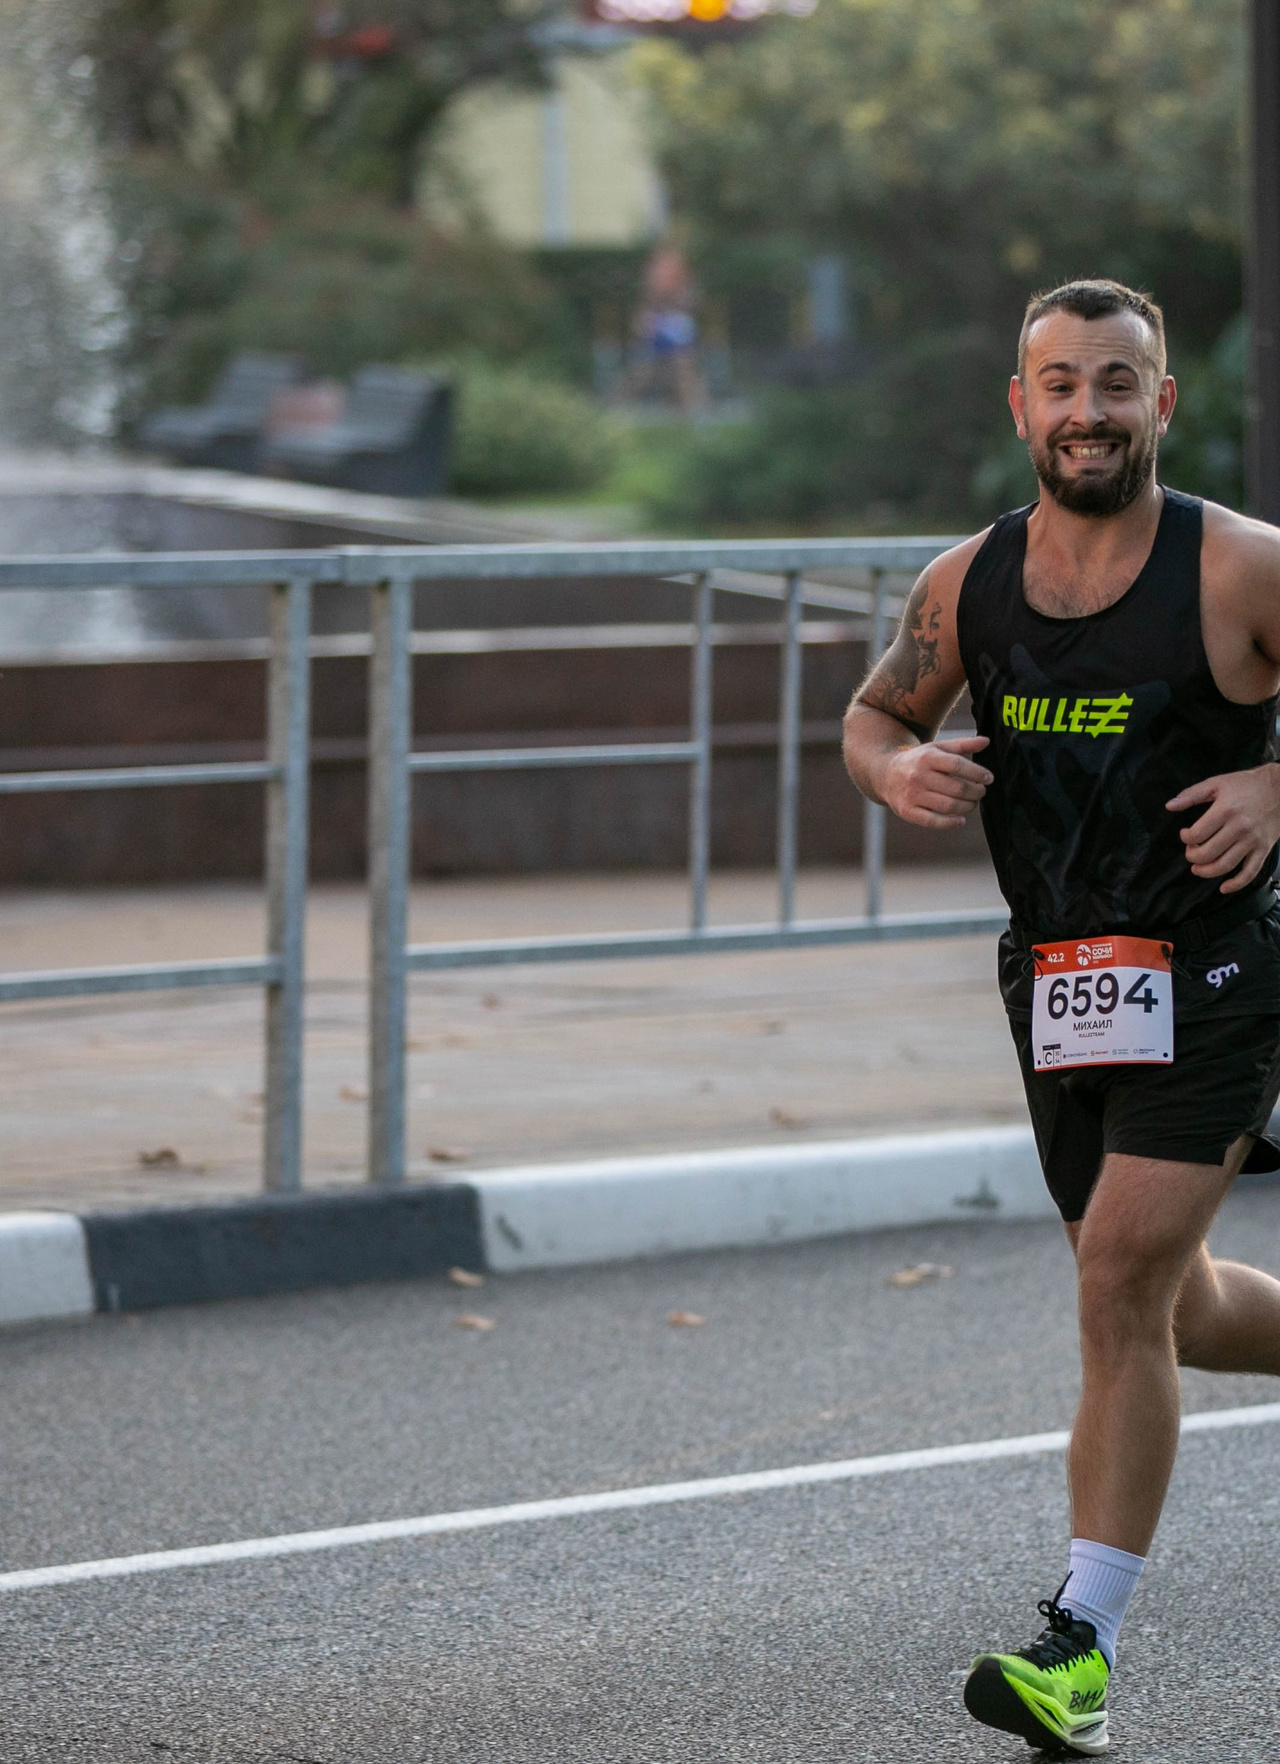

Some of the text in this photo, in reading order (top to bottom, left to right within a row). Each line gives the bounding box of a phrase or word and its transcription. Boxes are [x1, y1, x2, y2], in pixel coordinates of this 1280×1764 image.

[1002, 692, 1134, 739] RULLEZ
[1047, 952, 1065, 963] 42.2
[1092, 946, 1113, 956] СОЧИ
[1047, 972, 1159, 1020] 6594
[1073, 1019, 1113, 1032] МИХАИЛ
